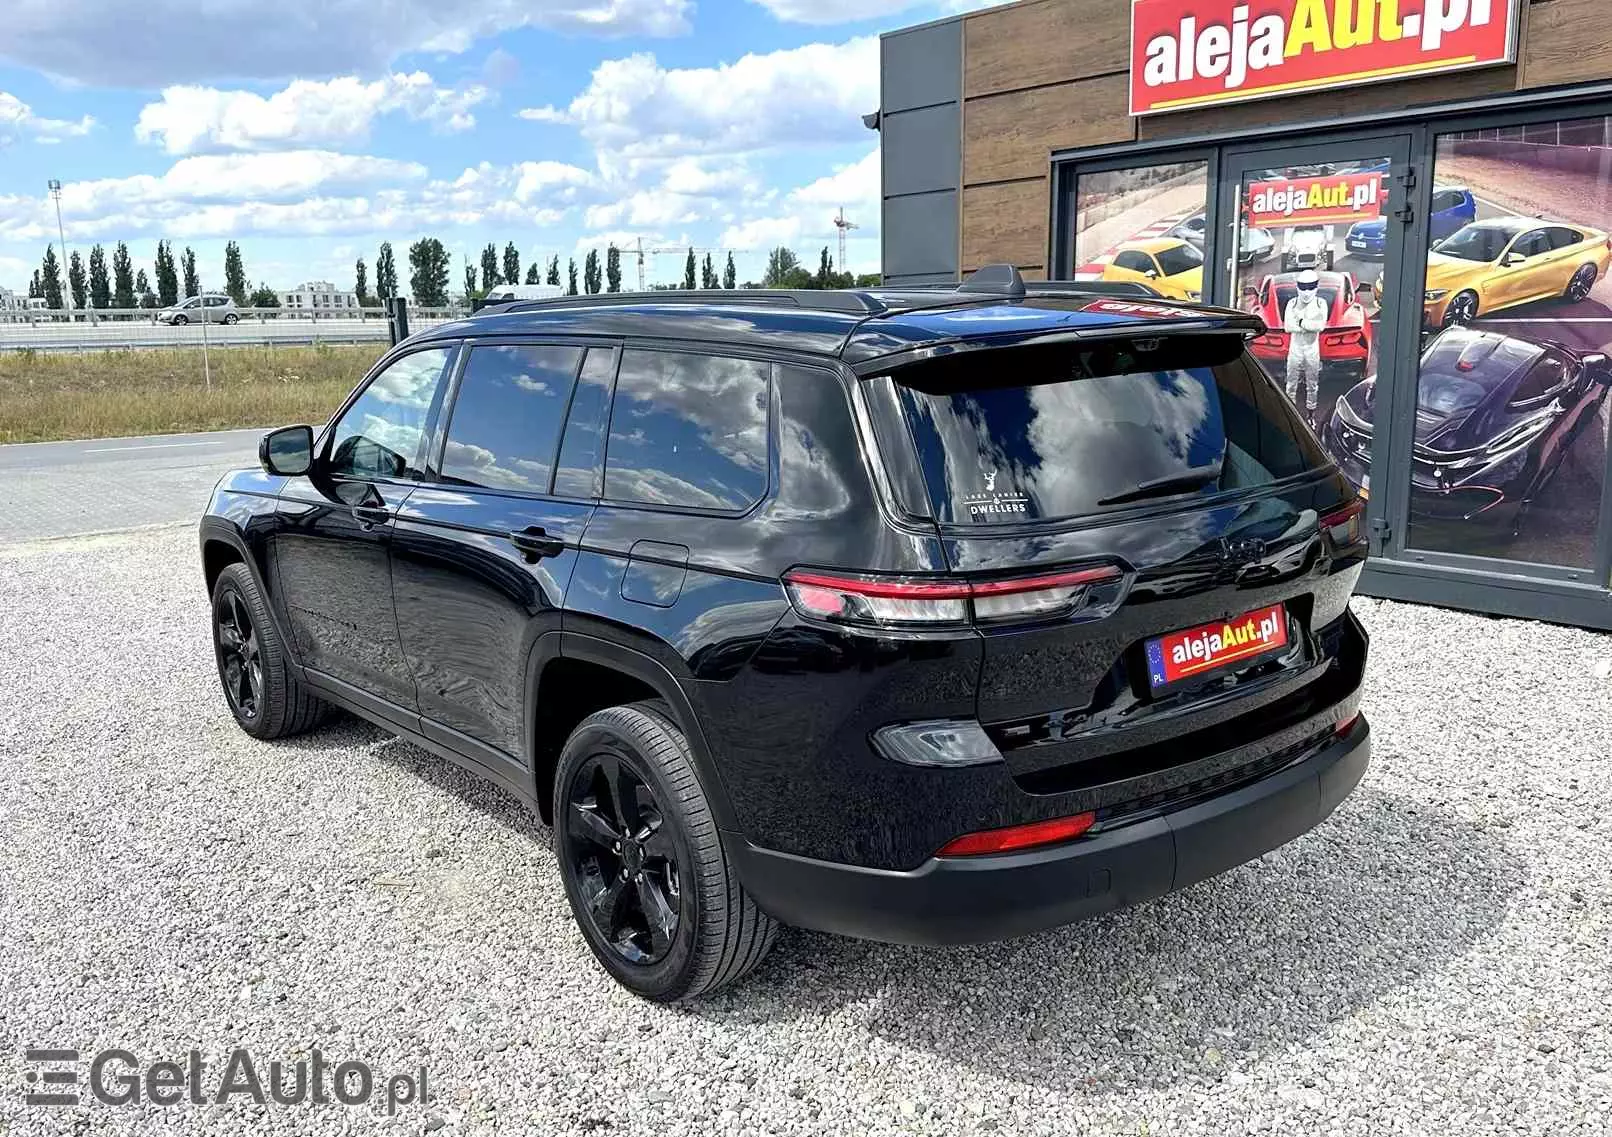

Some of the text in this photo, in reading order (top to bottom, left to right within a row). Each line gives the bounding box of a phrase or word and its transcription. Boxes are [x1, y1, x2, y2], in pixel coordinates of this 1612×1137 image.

[1252, 177, 1378, 217] alejaAut.pl
[970, 504, 1026, 515] DWELLERS
[1172, 611, 1279, 664] alejaAut.pl
[1153, 674, 1164, 684] PL
